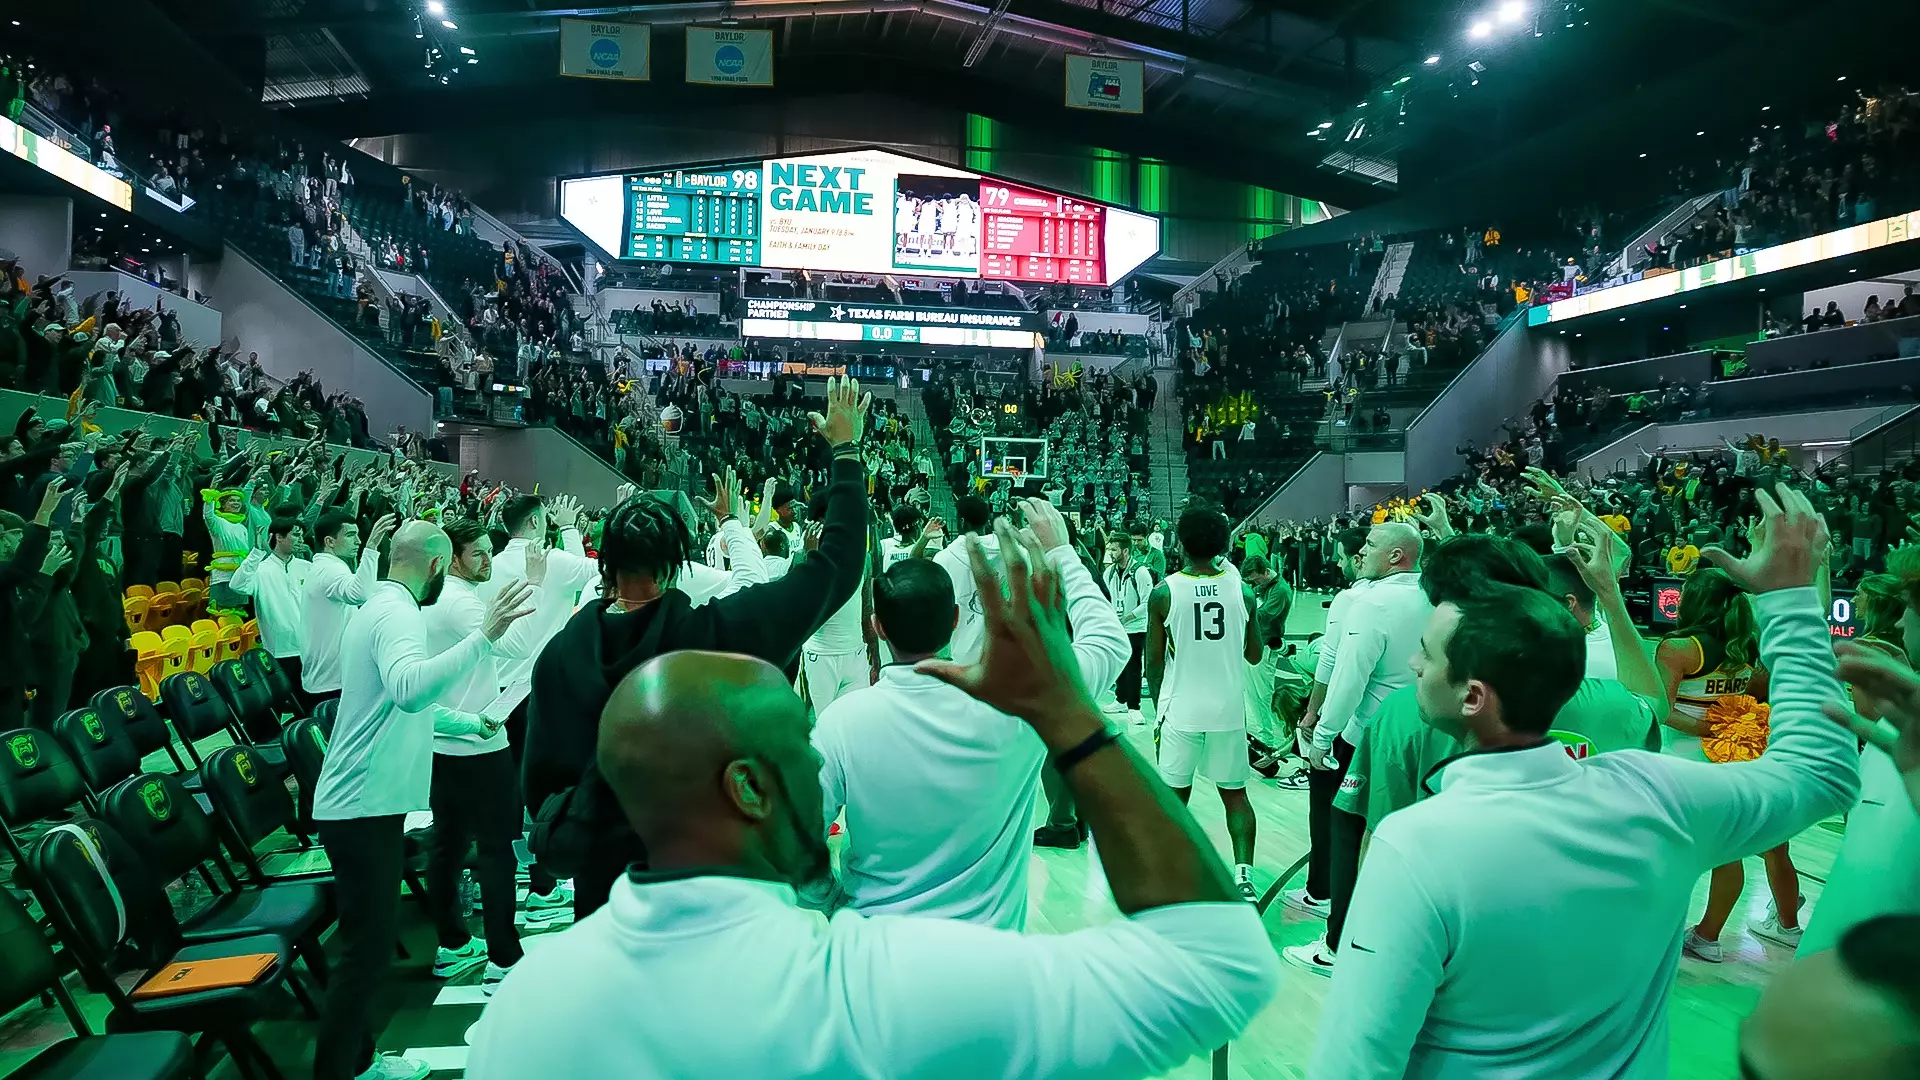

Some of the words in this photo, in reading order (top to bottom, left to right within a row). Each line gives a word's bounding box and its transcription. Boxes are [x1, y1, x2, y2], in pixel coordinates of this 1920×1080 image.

[591, 25, 620, 34] BAYLOR
[715, 32, 744, 41] BAYLOR
[593, 52, 619, 60] NCAA
[1092, 60, 1118, 70] BAYLOR
[690, 174, 728, 188] BAYLOR
[732, 170, 759, 190] 98
[771, 162, 865, 190] NEXT
[770, 187, 873, 215] GAME
[985, 187, 1010, 206] 79
[769, 225, 798, 234] TUESDAY,
[801, 227, 830, 235] JANUARY
[794, 242, 817, 250] FAMILY
[747, 300, 816, 312] CHAMPIONSHIP
[747, 309, 789, 319] PARTNER
[847, 308, 883, 320] TEXAS
[884, 310, 915, 322] FARM
[916, 312, 958, 324] BUREAU
[960, 314, 1022, 327] INSURANCE
[872, 327, 892, 339] 0.0
[1004, 404, 1018, 414] 00
[1195, 585, 1218, 597] LOVE
[1193, 602, 1225, 640] 13
[1705, 677, 1749, 694] BEARS
